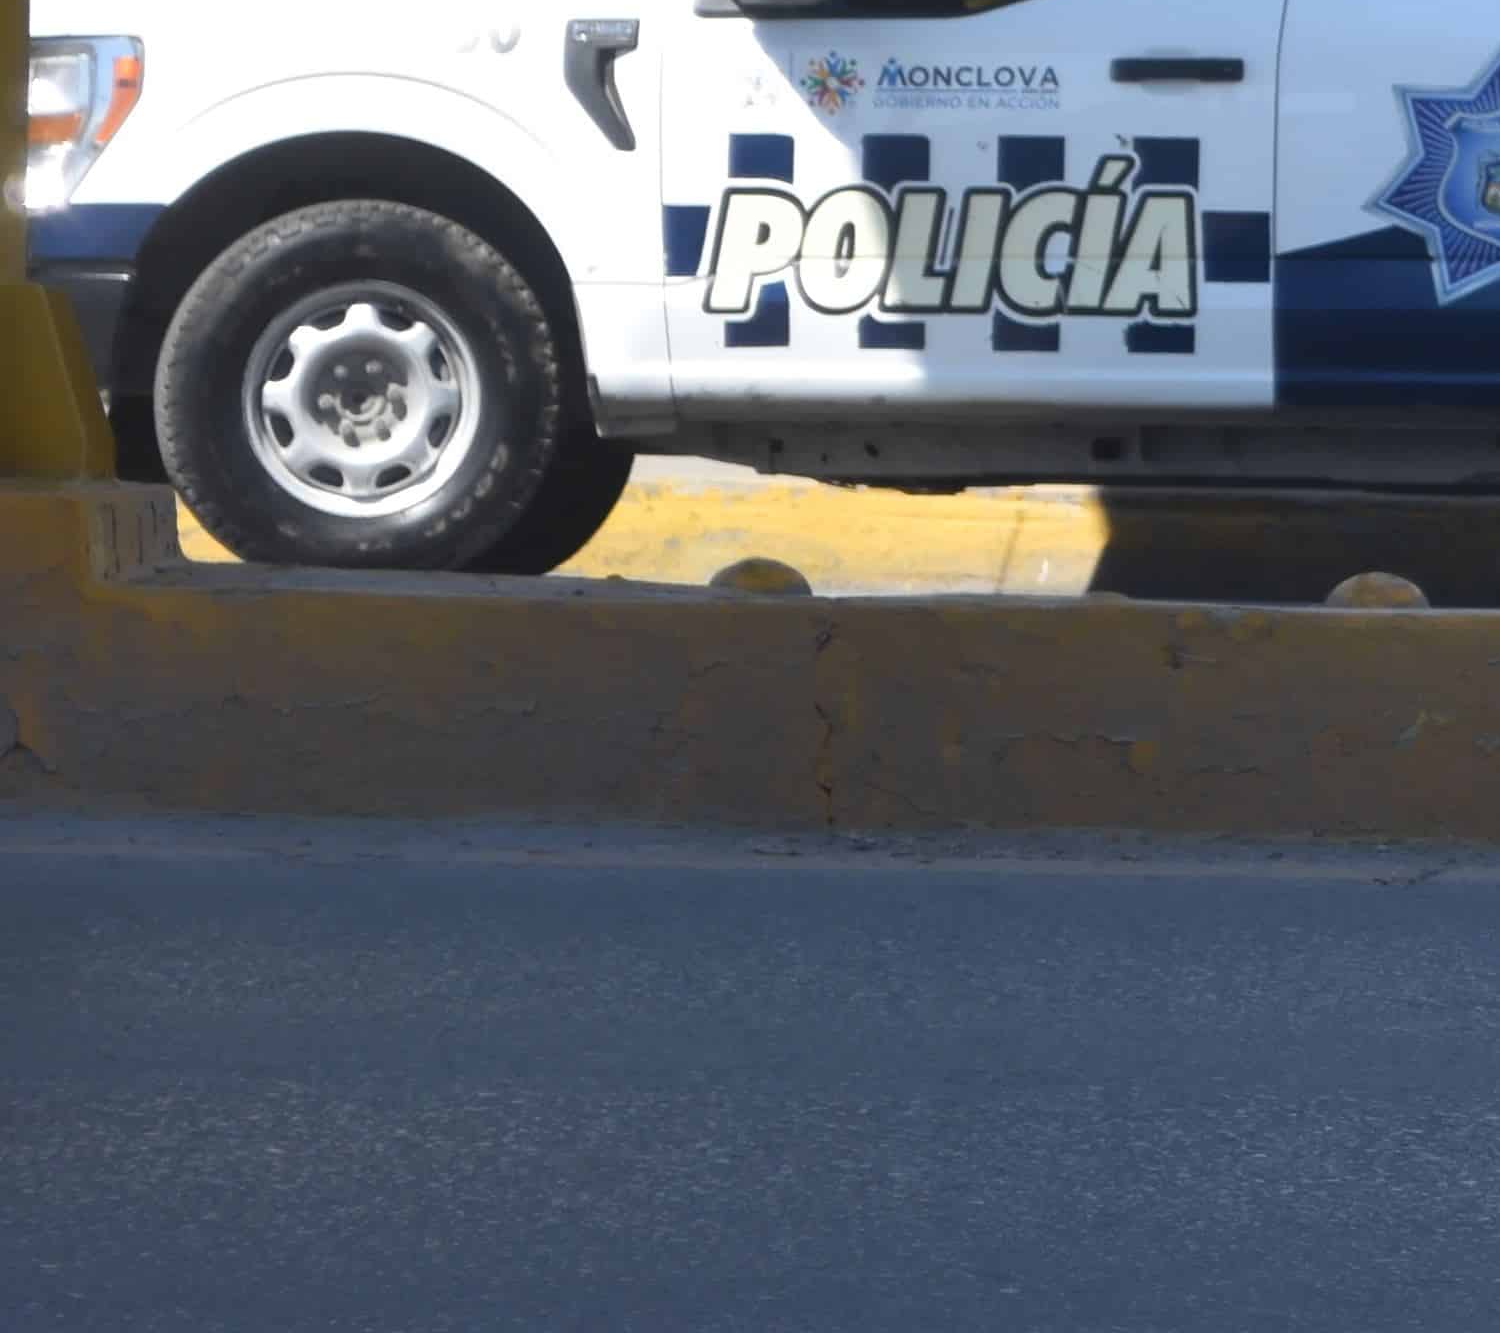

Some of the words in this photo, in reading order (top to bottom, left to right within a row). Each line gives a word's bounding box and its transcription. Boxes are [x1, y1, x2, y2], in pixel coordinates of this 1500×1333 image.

[876, 58, 1061, 87] MONCLOVA
[872, 95, 960, 110] GOBIERNO
[967, 96, 990, 110] EN
[997, 92, 1060, 110] ACCIÓN
[703, 154, 1199, 315] POLICÍA
